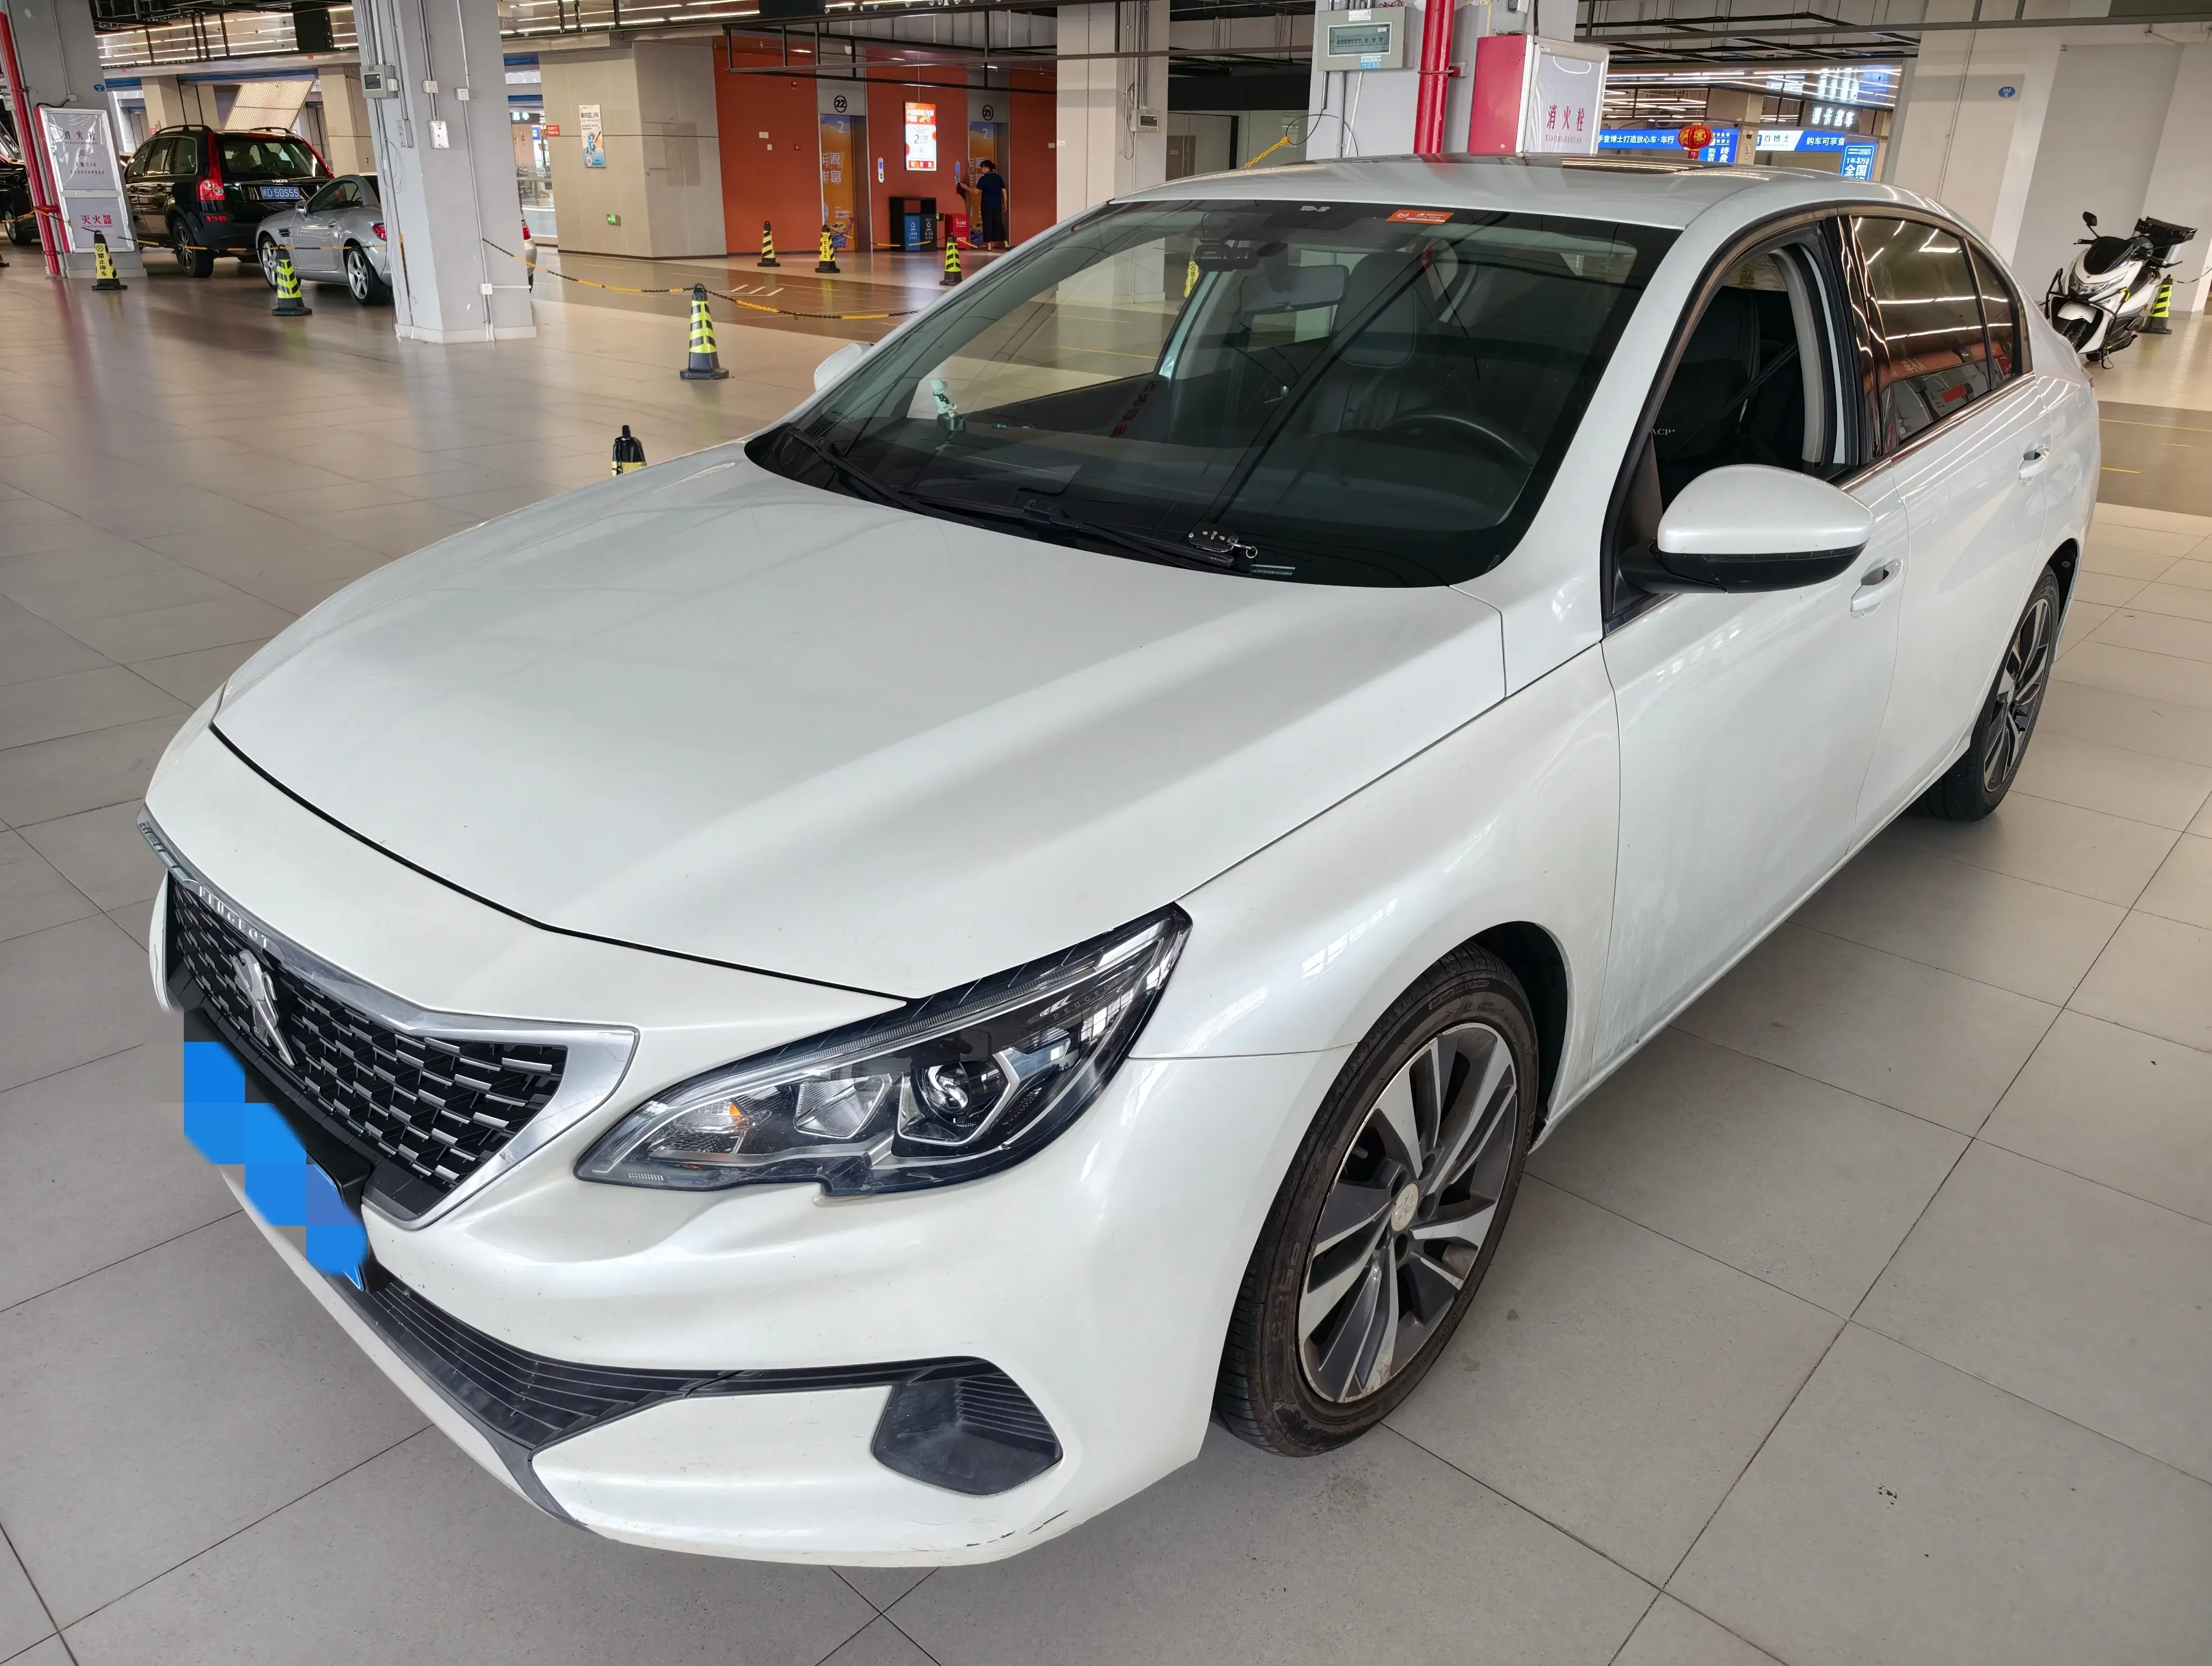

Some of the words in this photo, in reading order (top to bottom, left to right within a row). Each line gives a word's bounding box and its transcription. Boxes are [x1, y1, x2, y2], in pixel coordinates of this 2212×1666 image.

[1547, 105, 1584, 131] 消火栓
[838, 121, 845, 133] 2
[63, 131, 97, 140] 消火栓
[982, 129, 988, 140] 2
[1844, 164, 1868, 177] 全国
[80, 215, 112, 225] 灭火器
[97, 253, 108, 277] 禁止停车
[199, 886, 271, 948] PEUGEOT
[1053, 978, 1118, 1020] PEUGEOT
